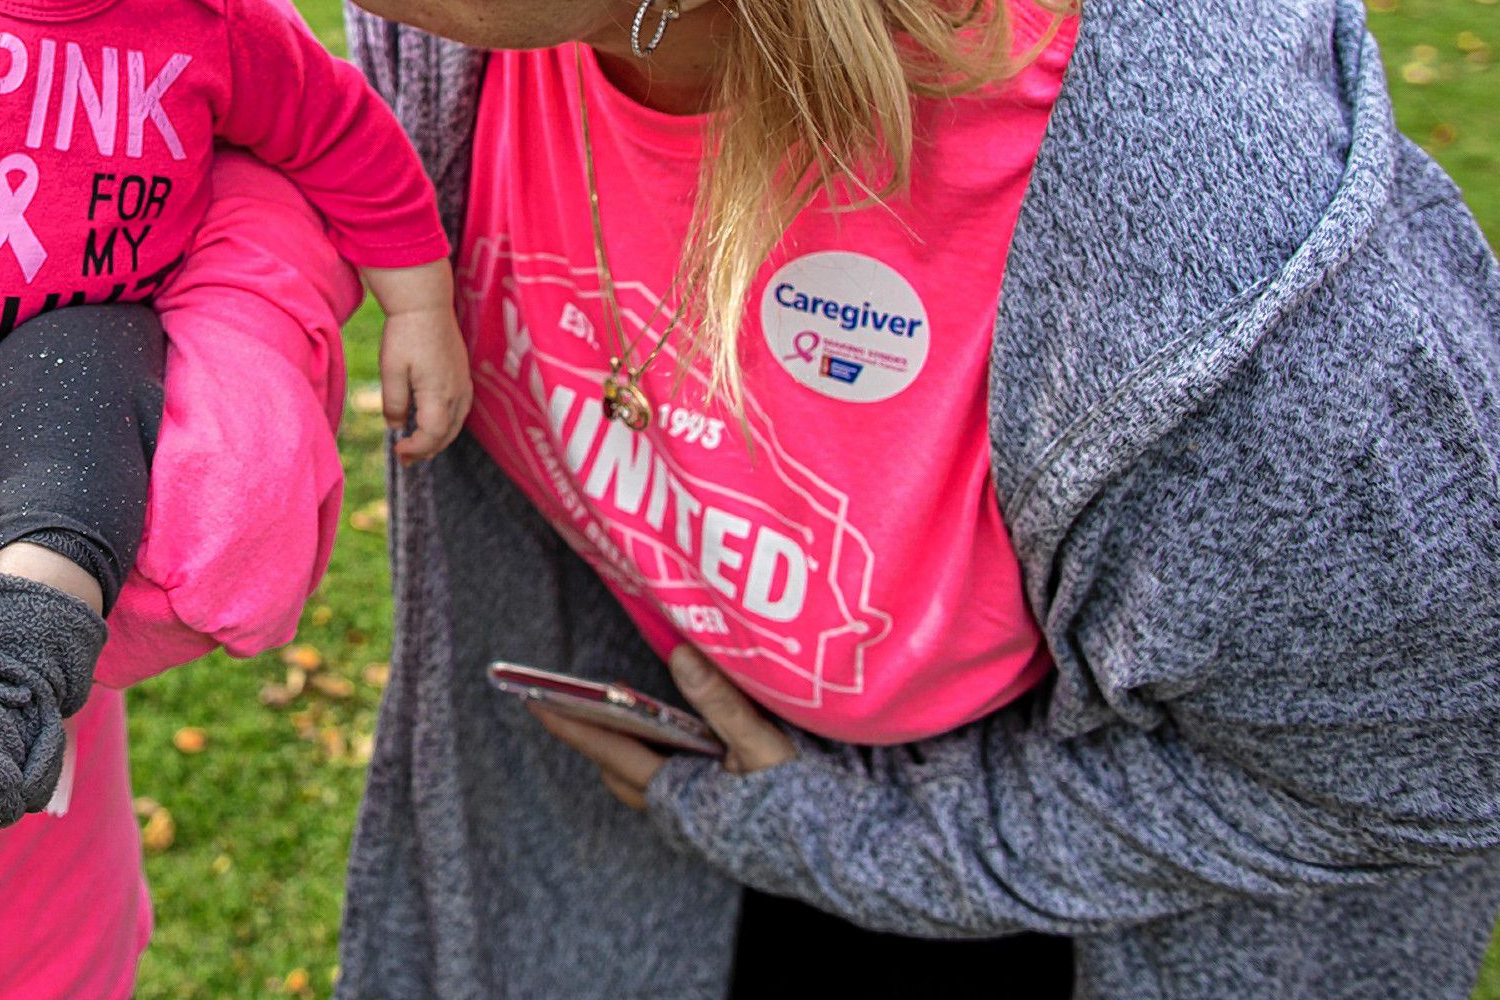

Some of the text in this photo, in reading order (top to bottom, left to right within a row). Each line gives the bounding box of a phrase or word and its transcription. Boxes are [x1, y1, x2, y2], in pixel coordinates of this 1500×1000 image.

[88, 173, 173, 221] FOR
[82, 225, 153, 277] MY
[774, 281, 923, 339] Caregiver
